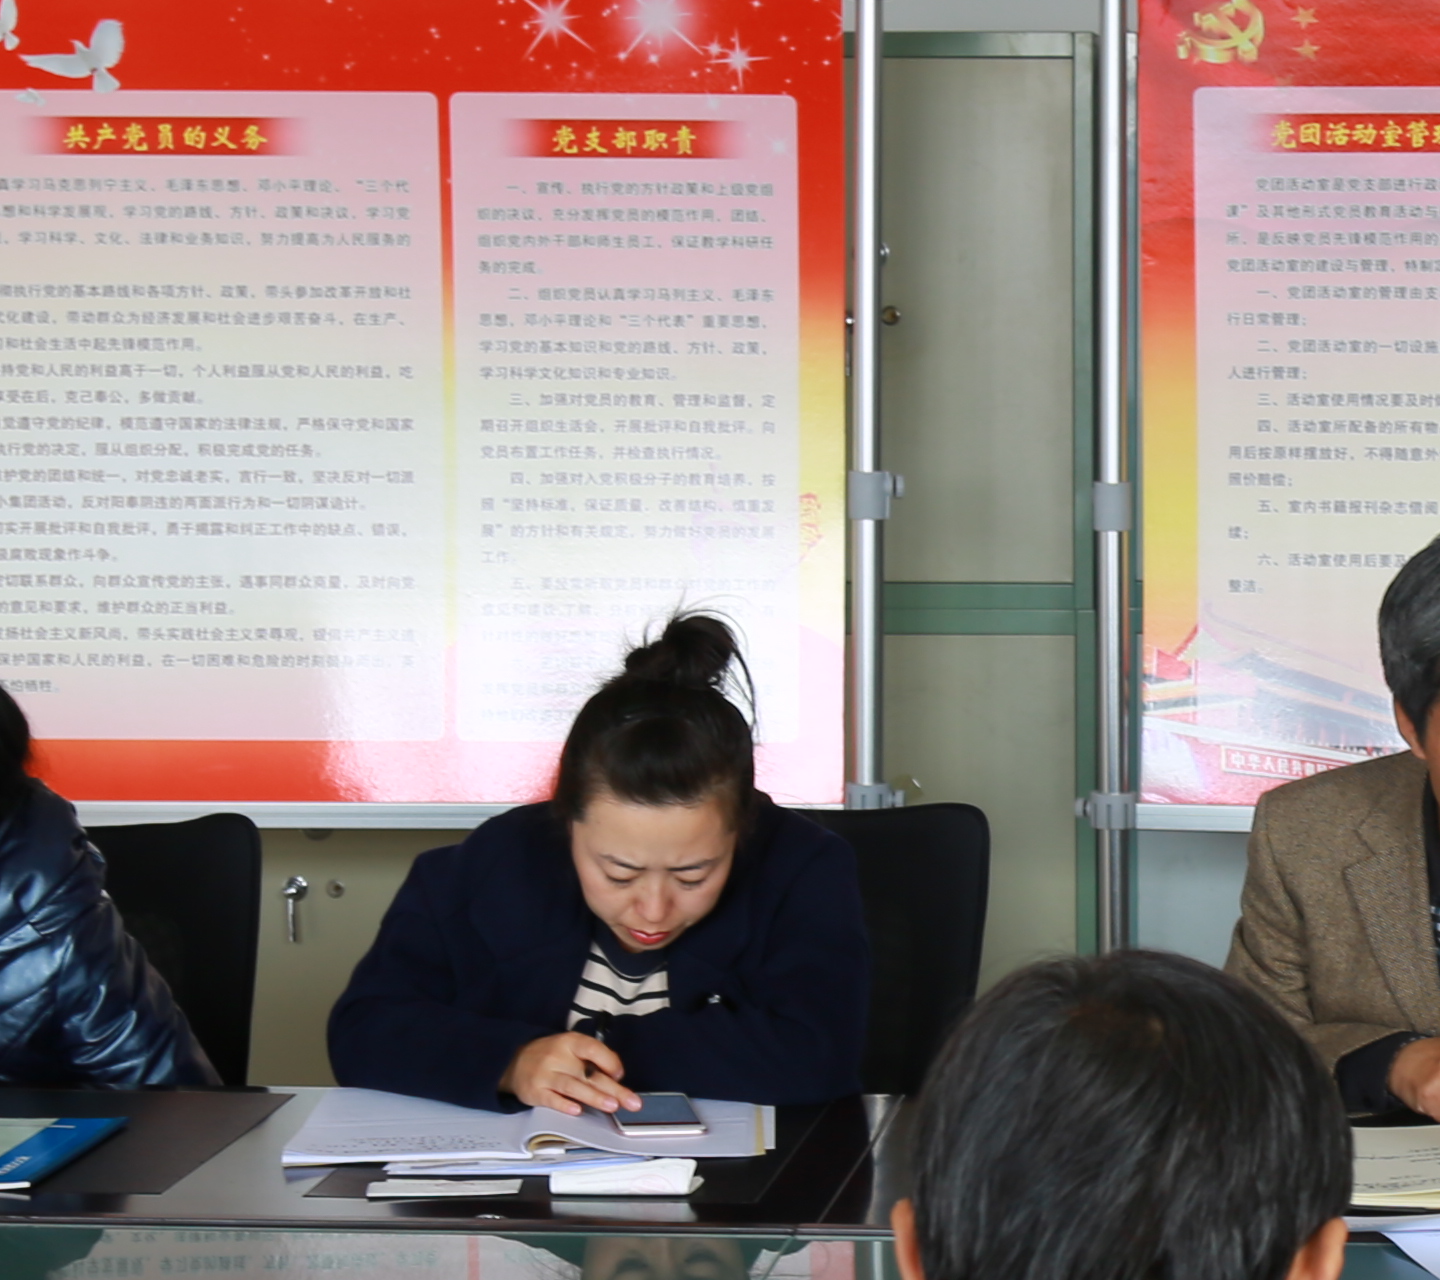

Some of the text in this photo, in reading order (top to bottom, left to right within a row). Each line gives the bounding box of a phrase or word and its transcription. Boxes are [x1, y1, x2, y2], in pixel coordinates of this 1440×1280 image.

[63, 122, 268, 151] 共产党员的义务
[552, 126, 698, 155] 党支部职责
